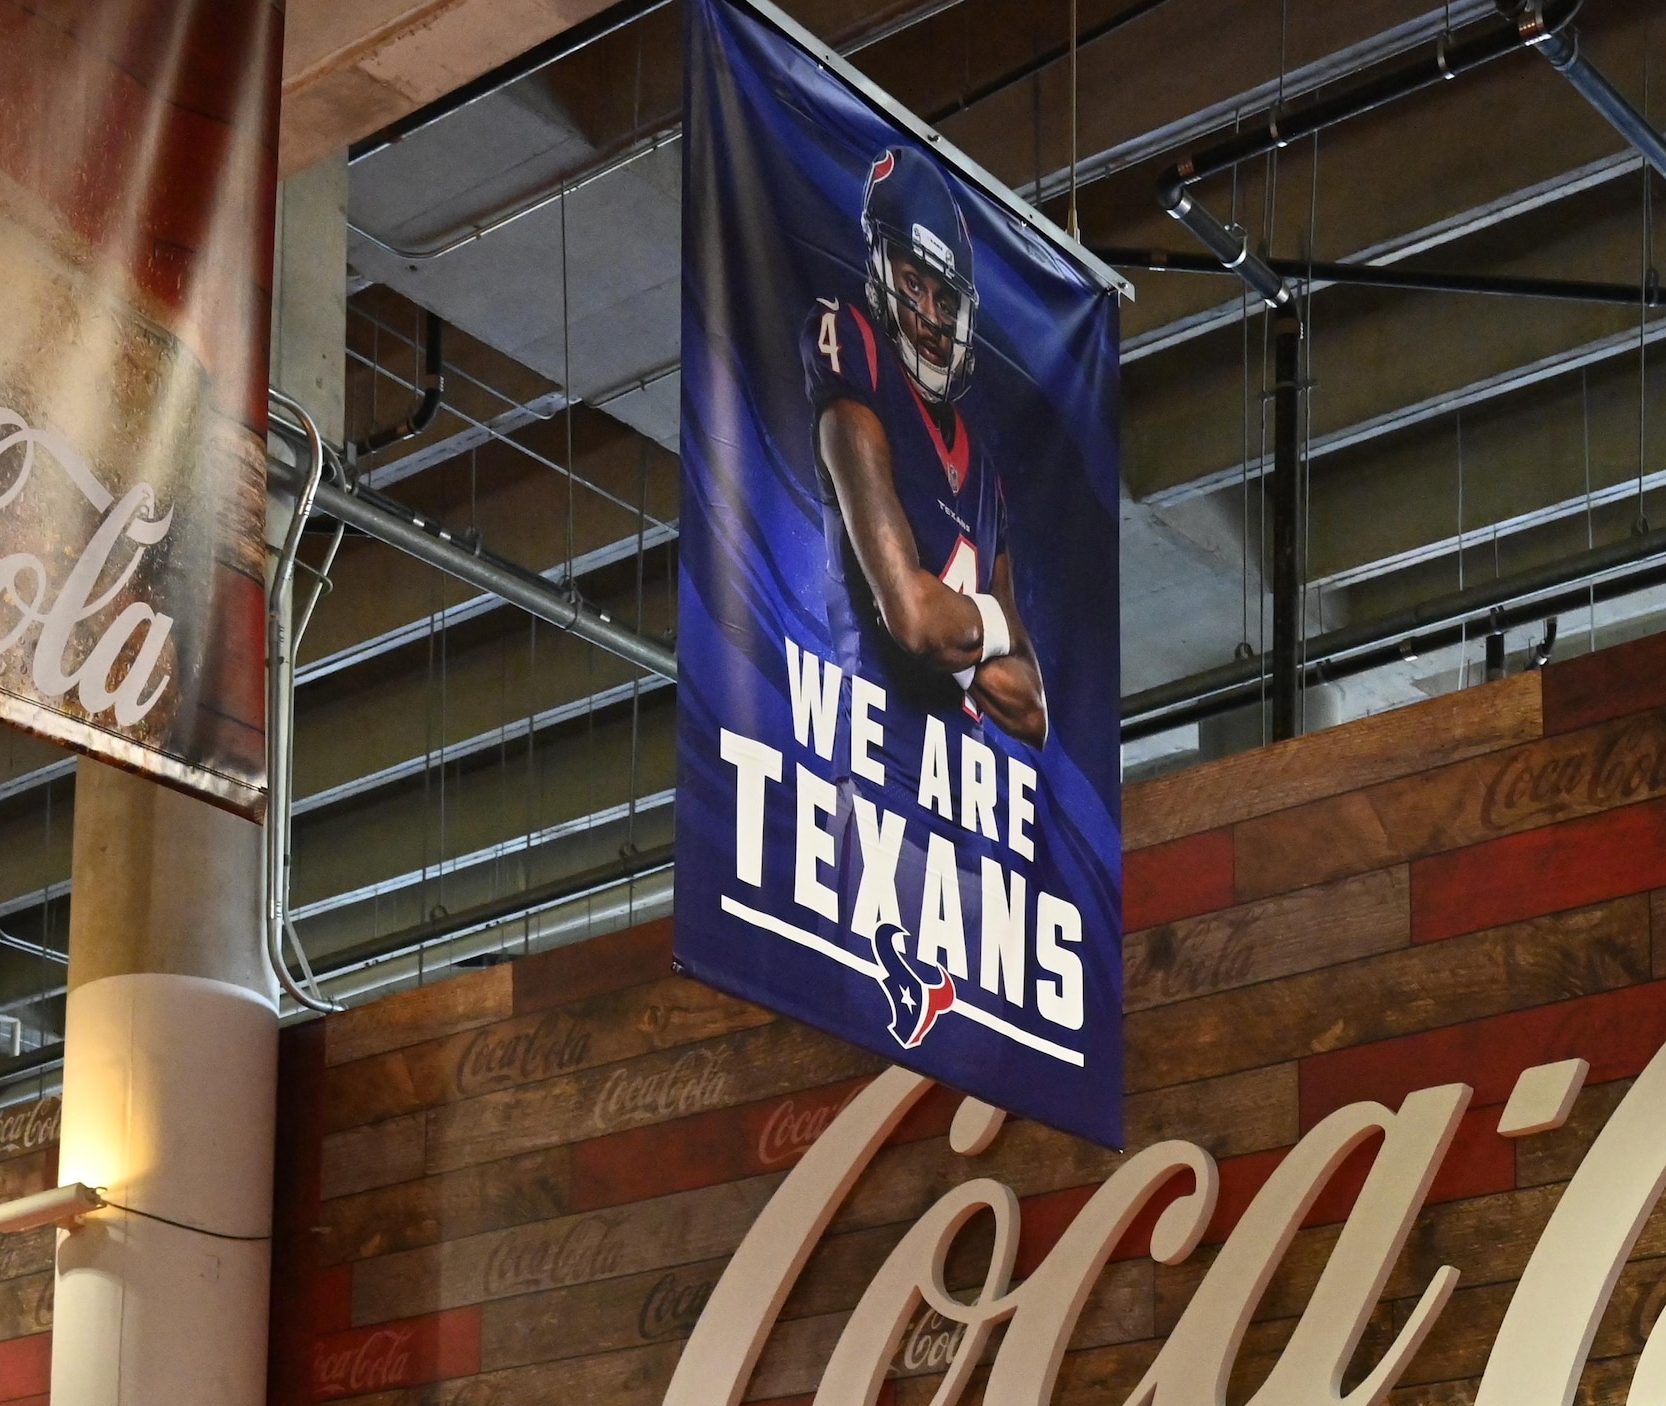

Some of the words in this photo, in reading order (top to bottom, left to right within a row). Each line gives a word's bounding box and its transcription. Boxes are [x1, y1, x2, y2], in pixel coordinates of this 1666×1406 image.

[816, 312, 841, 372] 4
[938, 499, 971, 533] TEXANS
[785, 637, 886, 787] WE
[918, 715, 1037, 863] ARE
[721, 728, 1085, 1031] TEXANS
